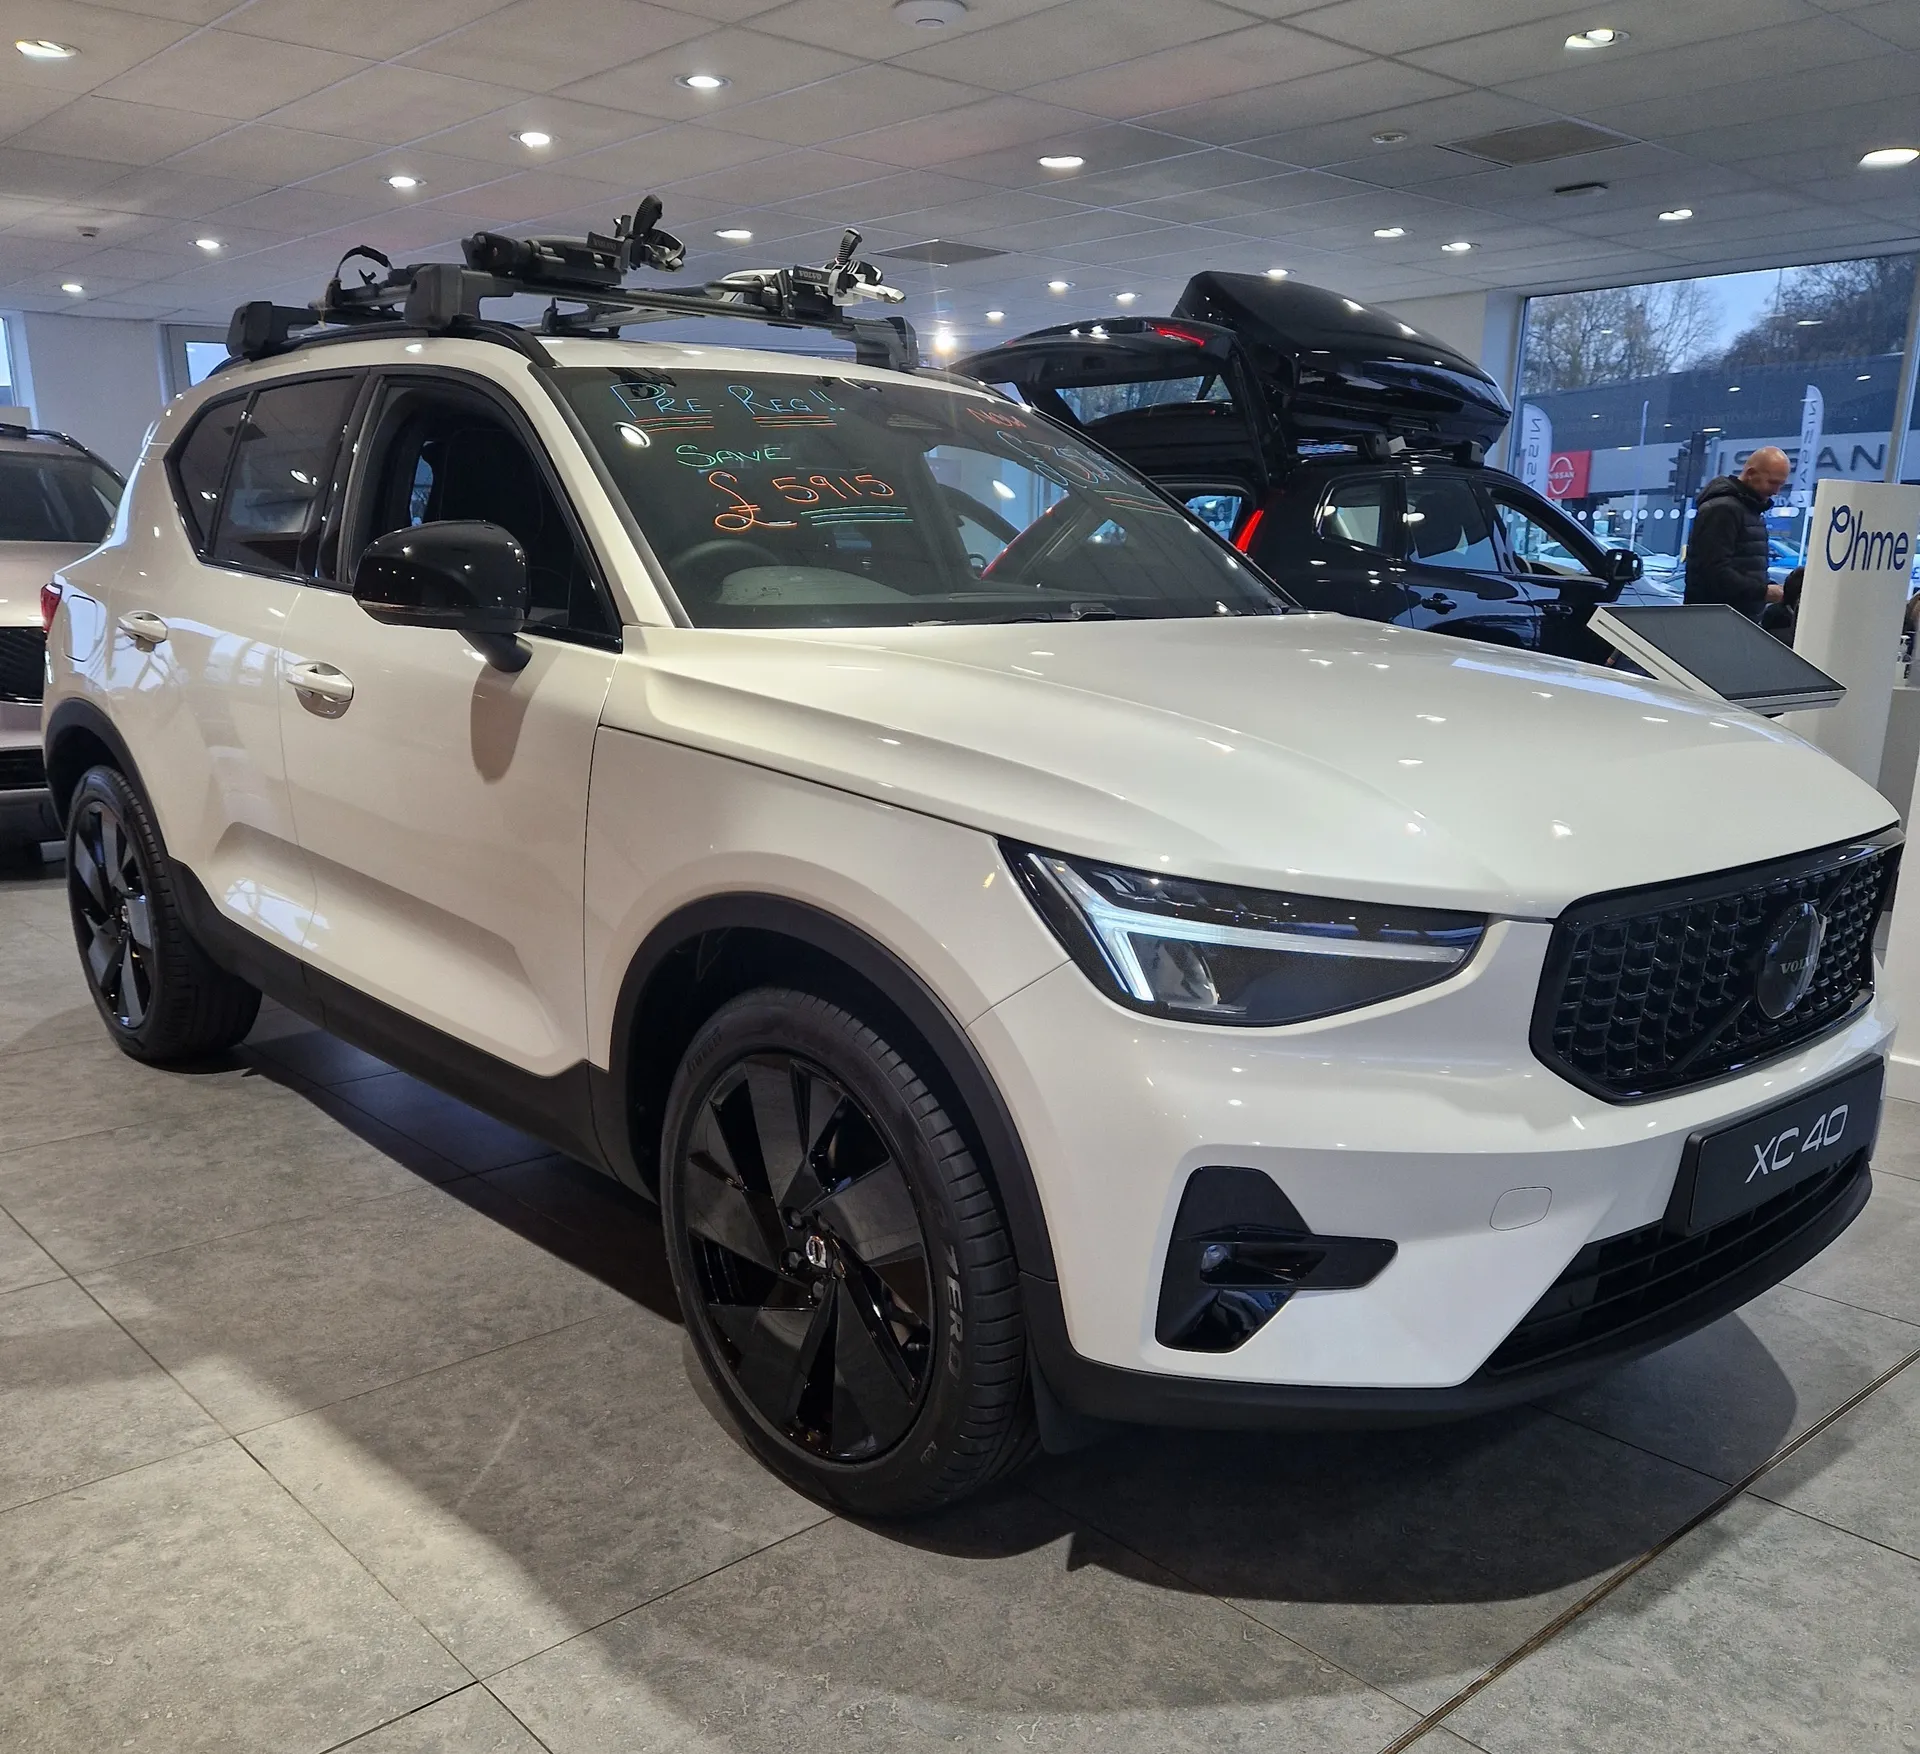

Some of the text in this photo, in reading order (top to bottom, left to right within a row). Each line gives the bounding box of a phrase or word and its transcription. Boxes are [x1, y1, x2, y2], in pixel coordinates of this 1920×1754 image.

[676, 445, 791, 467] SAVE
[1826, 504, 1909, 571] Ohme
[1745, 1104, 1848, 1184] XC 40
